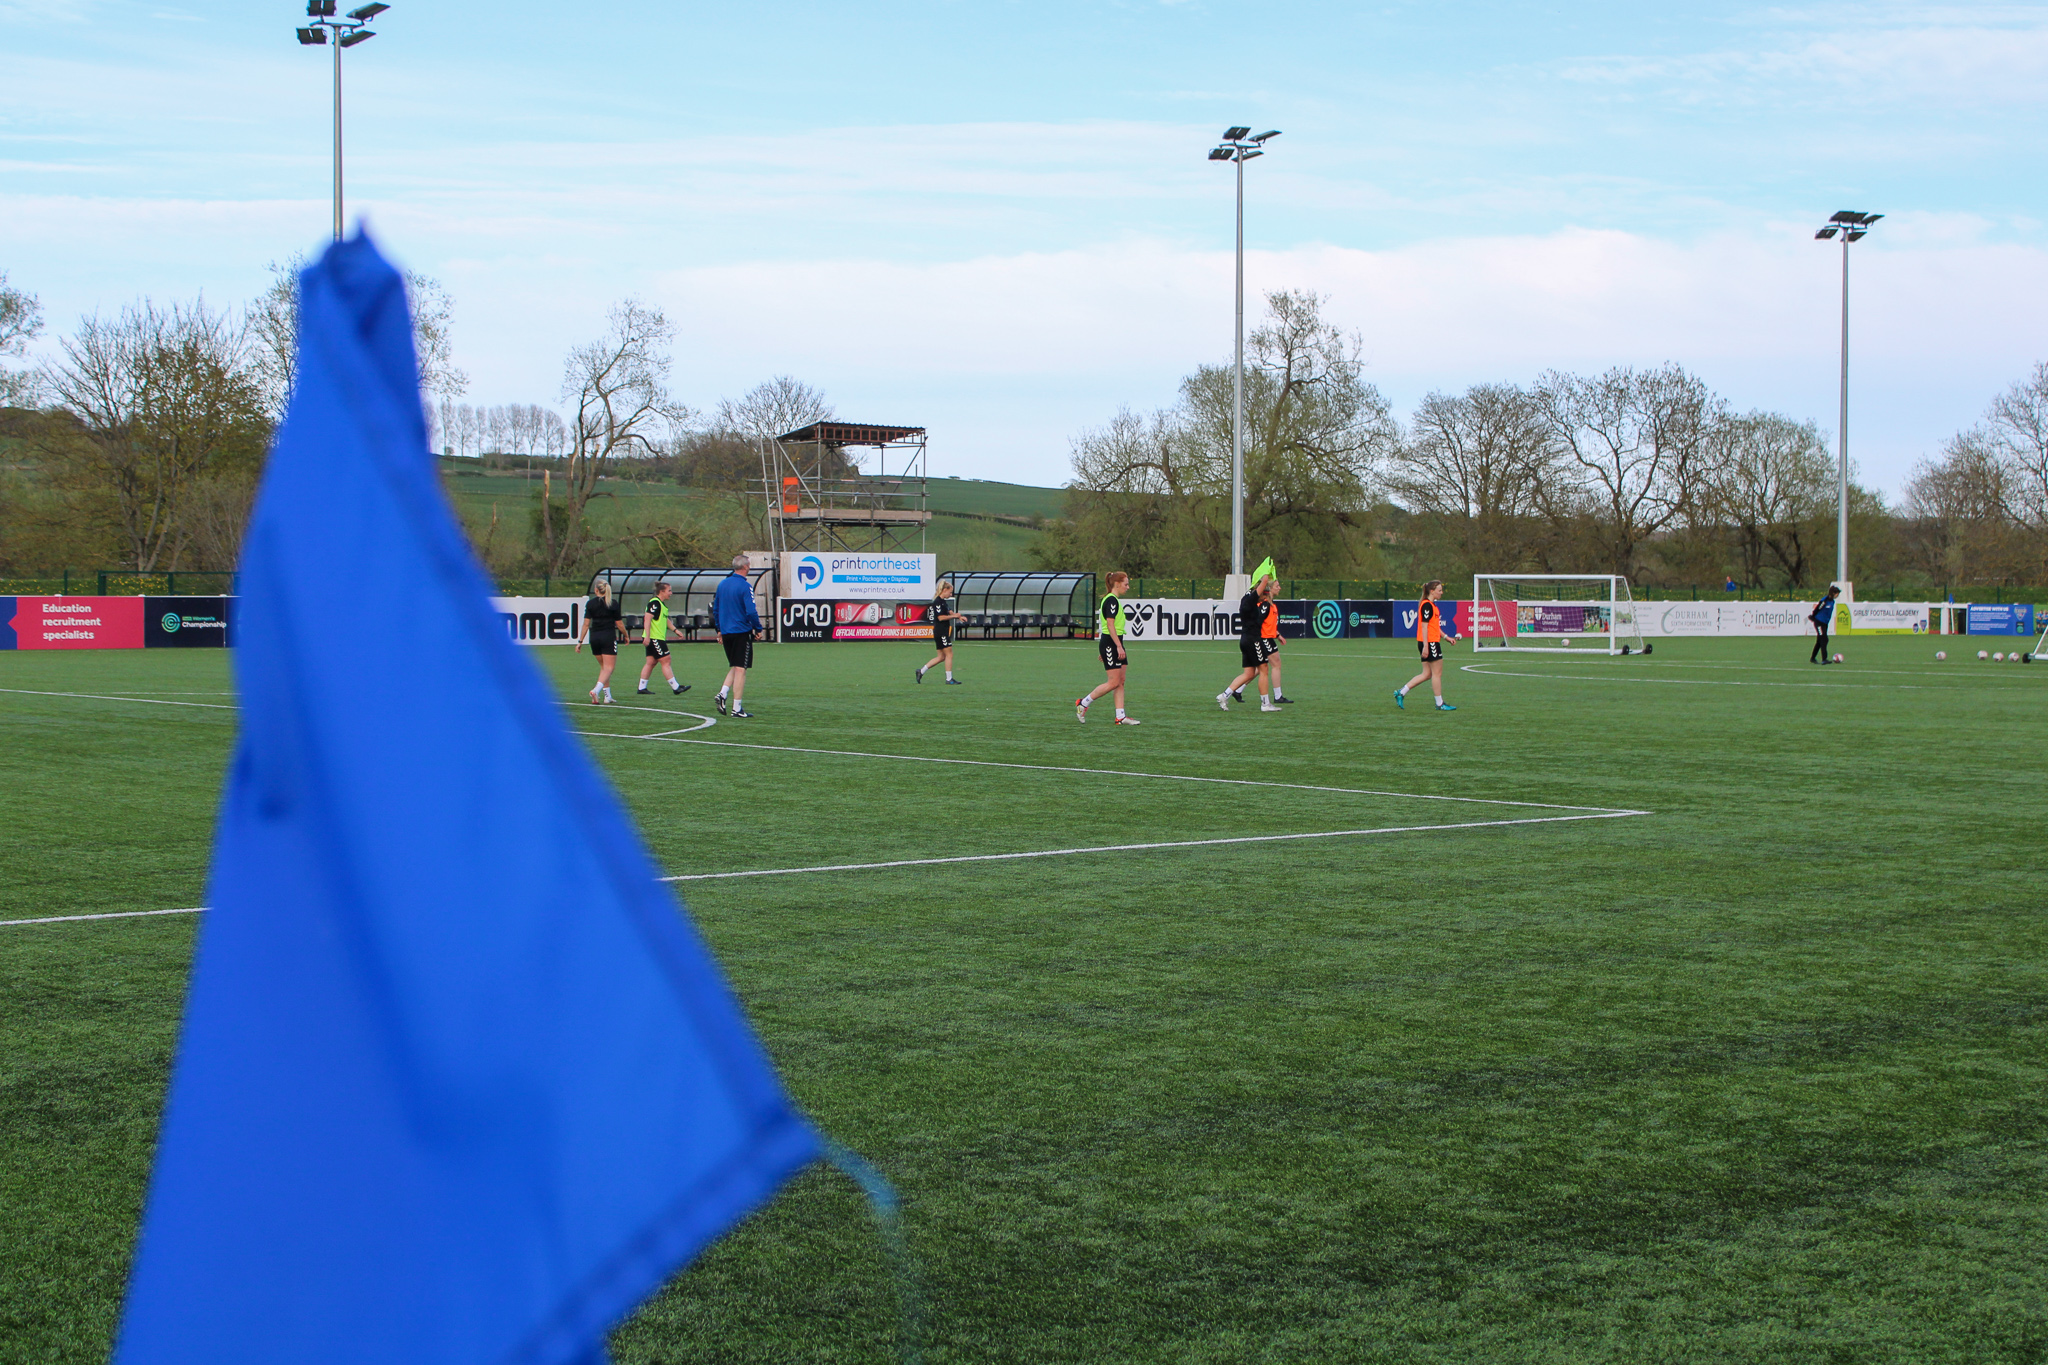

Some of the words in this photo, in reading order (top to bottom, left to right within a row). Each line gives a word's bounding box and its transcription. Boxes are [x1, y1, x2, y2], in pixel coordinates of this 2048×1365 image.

[832, 557, 921, 572] printnortheast
[42, 604, 92, 613] Education
[1675, 611, 1708, 619] DURHAM
[1755, 609, 1800, 627] interplan
[43, 616, 101, 626] recruitment
[43, 630, 94, 641] specialists
[836, 628, 855, 637] OFFICIAL
[856, 628, 881, 637] HYDRATION
[882, 628, 900, 637] DRINKS
[904, 628, 928, 637] WELLNESS
